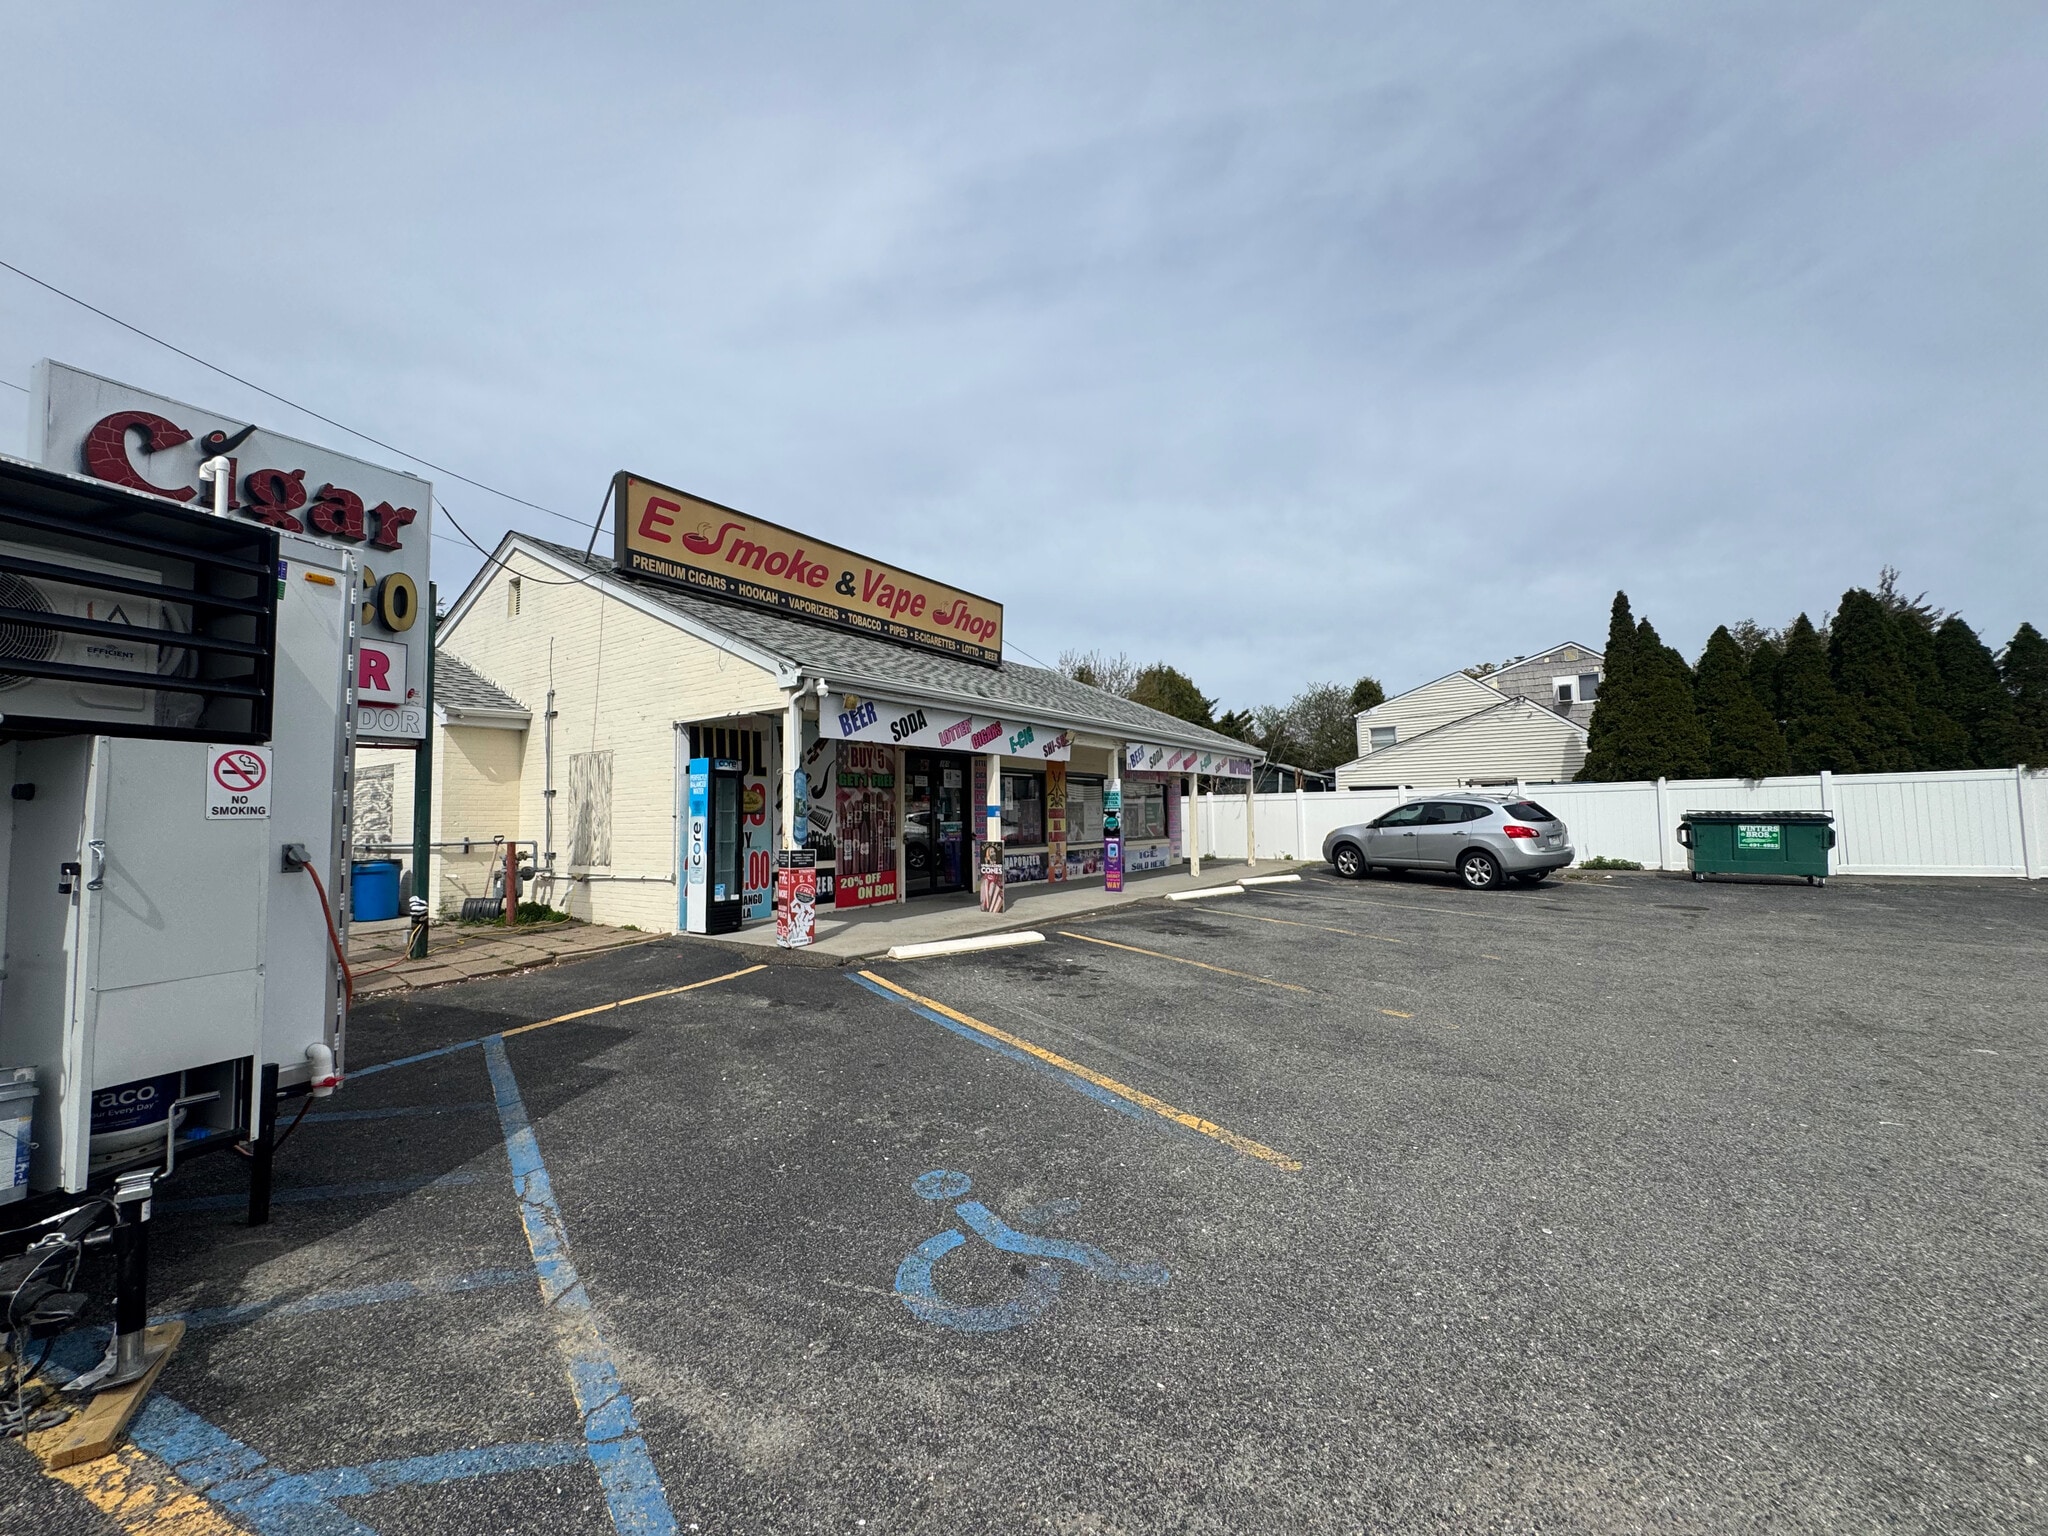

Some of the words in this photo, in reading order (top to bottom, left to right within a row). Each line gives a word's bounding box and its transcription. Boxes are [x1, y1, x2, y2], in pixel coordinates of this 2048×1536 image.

[86, 410, 418, 550] Cigar
[638, 496, 682, 544] E
[682, 521, 829, 588] Smoke
[835, 570, 856, 598] &
[861, 568, 926, 618] Vape
[932, 599, 997, 643] Shop
[632, 554, 686, 581] PREMIUM
[688, 570, 727, 591] CIGARS
[738, 583, 779, 606] HOOKAH
[788, 597, 840, 621] VAPORIZERS
[847, 613, 882, 632] TOBACCO
[889, 624, 909, 638] PIPES
[914, 632, 956, 651] E-CIGARETTES
[961, 643, 980, 657] LOTTO
[984, 649, 998, 663] BEER
[87, 646, 134, 658] EFFICIENT
[838, 701, 878, 737] BEER
[890, 708, 928, 742] SODA
[971, 720, 1003, 750] CIGARS
[1009, 725, 1035, 754] E-CIG
[851, 746, 873, 769] BUY
[877, 748, 885, 769] 5
[1129, 744, 1145, 768] BEER
[1149, 747, 1164, 769] SODA
[838, 772, 860, 788] GET
[862, 775, 869, 788] 1
[871, 773, 895, 788] FREE
[231, 795, 249, 805] NO
[211, 806, 266, 815] SMOKING
[692, 821, 702, 866] core
[1139, 849, 1158, 859] ICE
[1131, 862, 1148, 871] SOLD
[1150, 860, 1165, 868] HERE
[840, 876, 863, 889] 20%
[865, 872, 881, 885] OFF
[858, 886, 873, 900] ON
[875, 882, 894, 898] BOX
[108, 1106, 134, 1117] Every
[137, 1102, 155, 1112] Day
